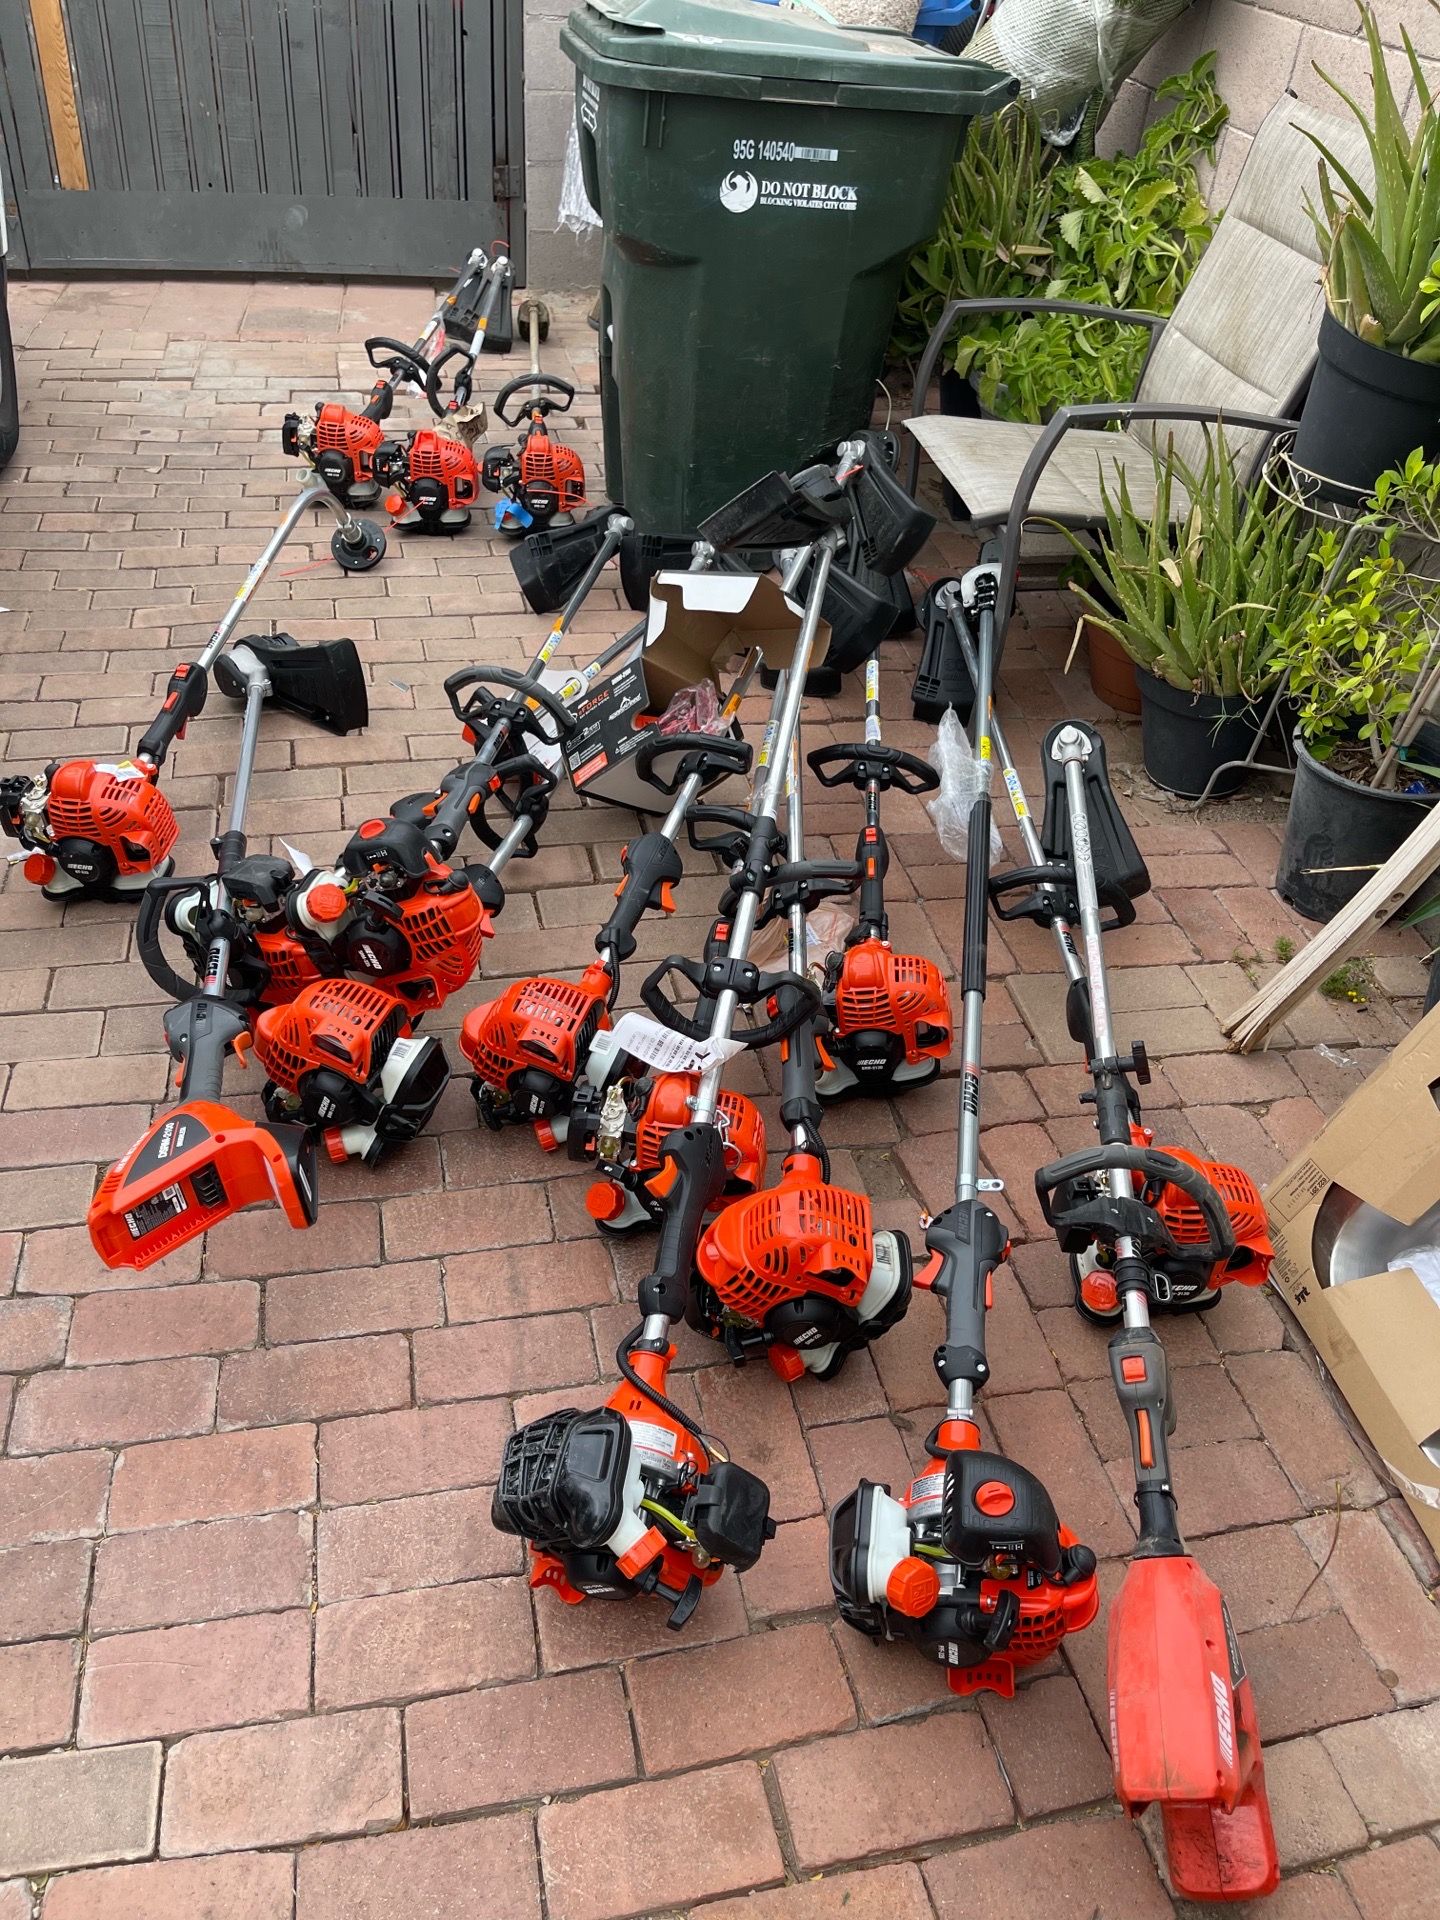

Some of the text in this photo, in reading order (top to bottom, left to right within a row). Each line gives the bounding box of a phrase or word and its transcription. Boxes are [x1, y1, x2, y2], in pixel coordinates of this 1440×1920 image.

[733, 139, 795, 162] 95G 140540
[760, 180, 858, 201] DO NOT BLOCK
[760, 197, 792, 207] BLOCKING
[793, 199, 822, 209] VIOLATES
[823, 201, 839, 210] CITY
[362, 944, 382, 969] ECHO
[964, 1071, 978, 1117] ECHO
[318, 1096, 330, 1117] ECHO
[793, 1327, 818, 1345] ECHO
[949, 1642, 958, 1664] ECHO
[1210, 1671, 1233, 1769] ECHO
